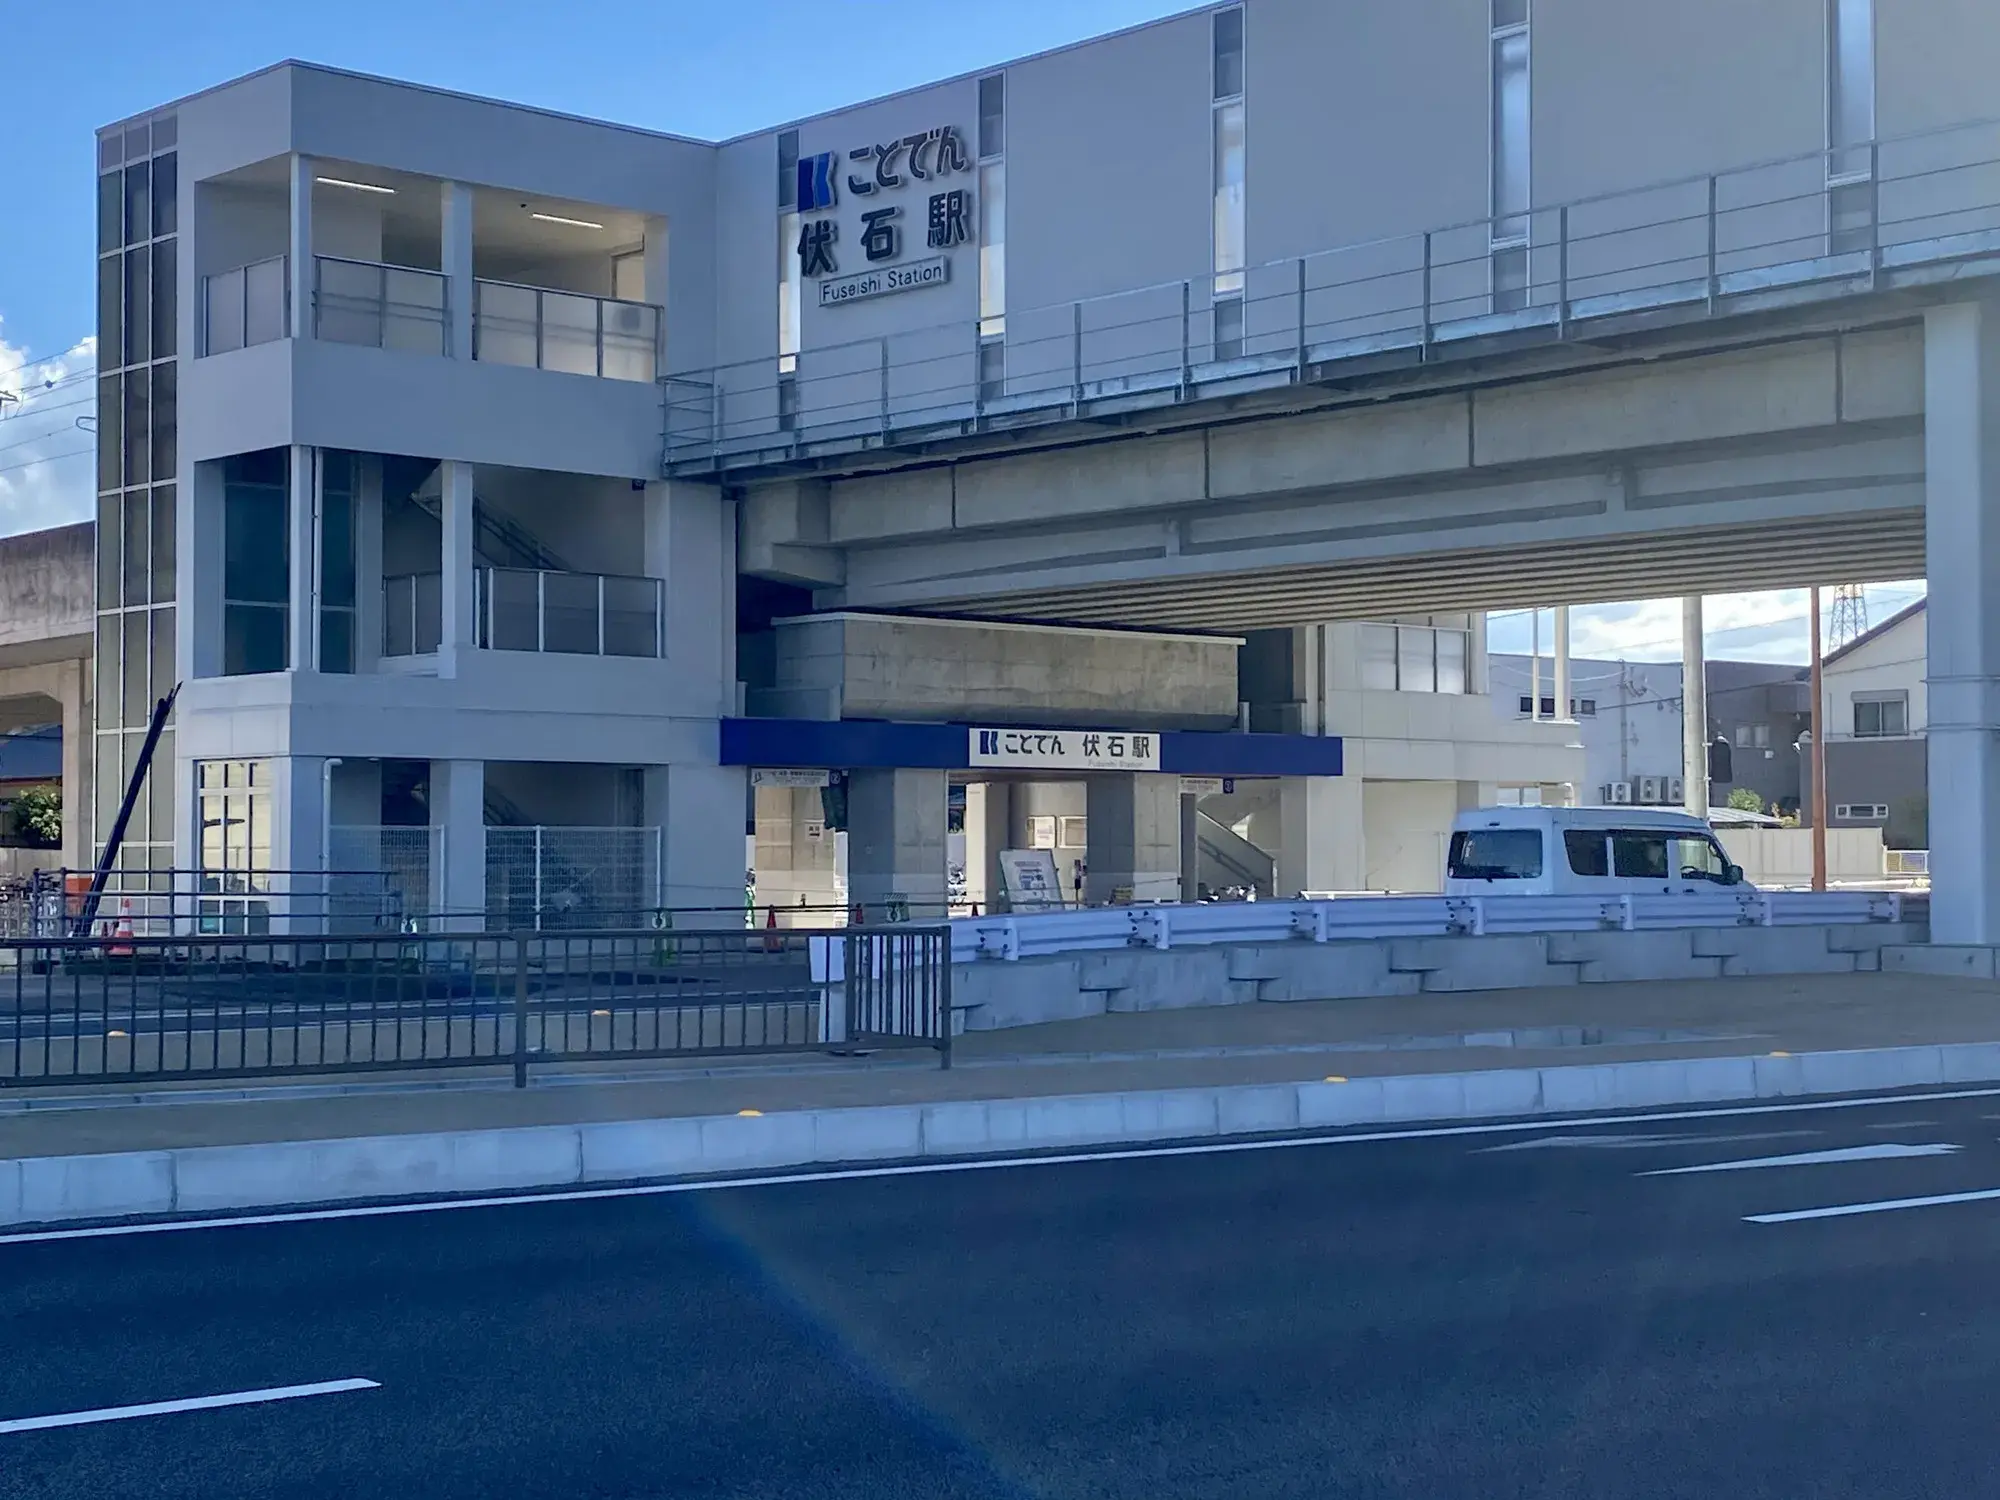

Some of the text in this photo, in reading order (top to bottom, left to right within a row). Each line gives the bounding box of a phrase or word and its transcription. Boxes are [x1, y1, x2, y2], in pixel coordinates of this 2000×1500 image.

[848, 125, 965, 195] ことでん
[797, 189, 966, 277] 伏石駅
[822, 264, 942, 302] Fuseishi Station
[1004, 733, 1066, 755] ことでん
[1081, 734, 1151, 759] 伏石駅
